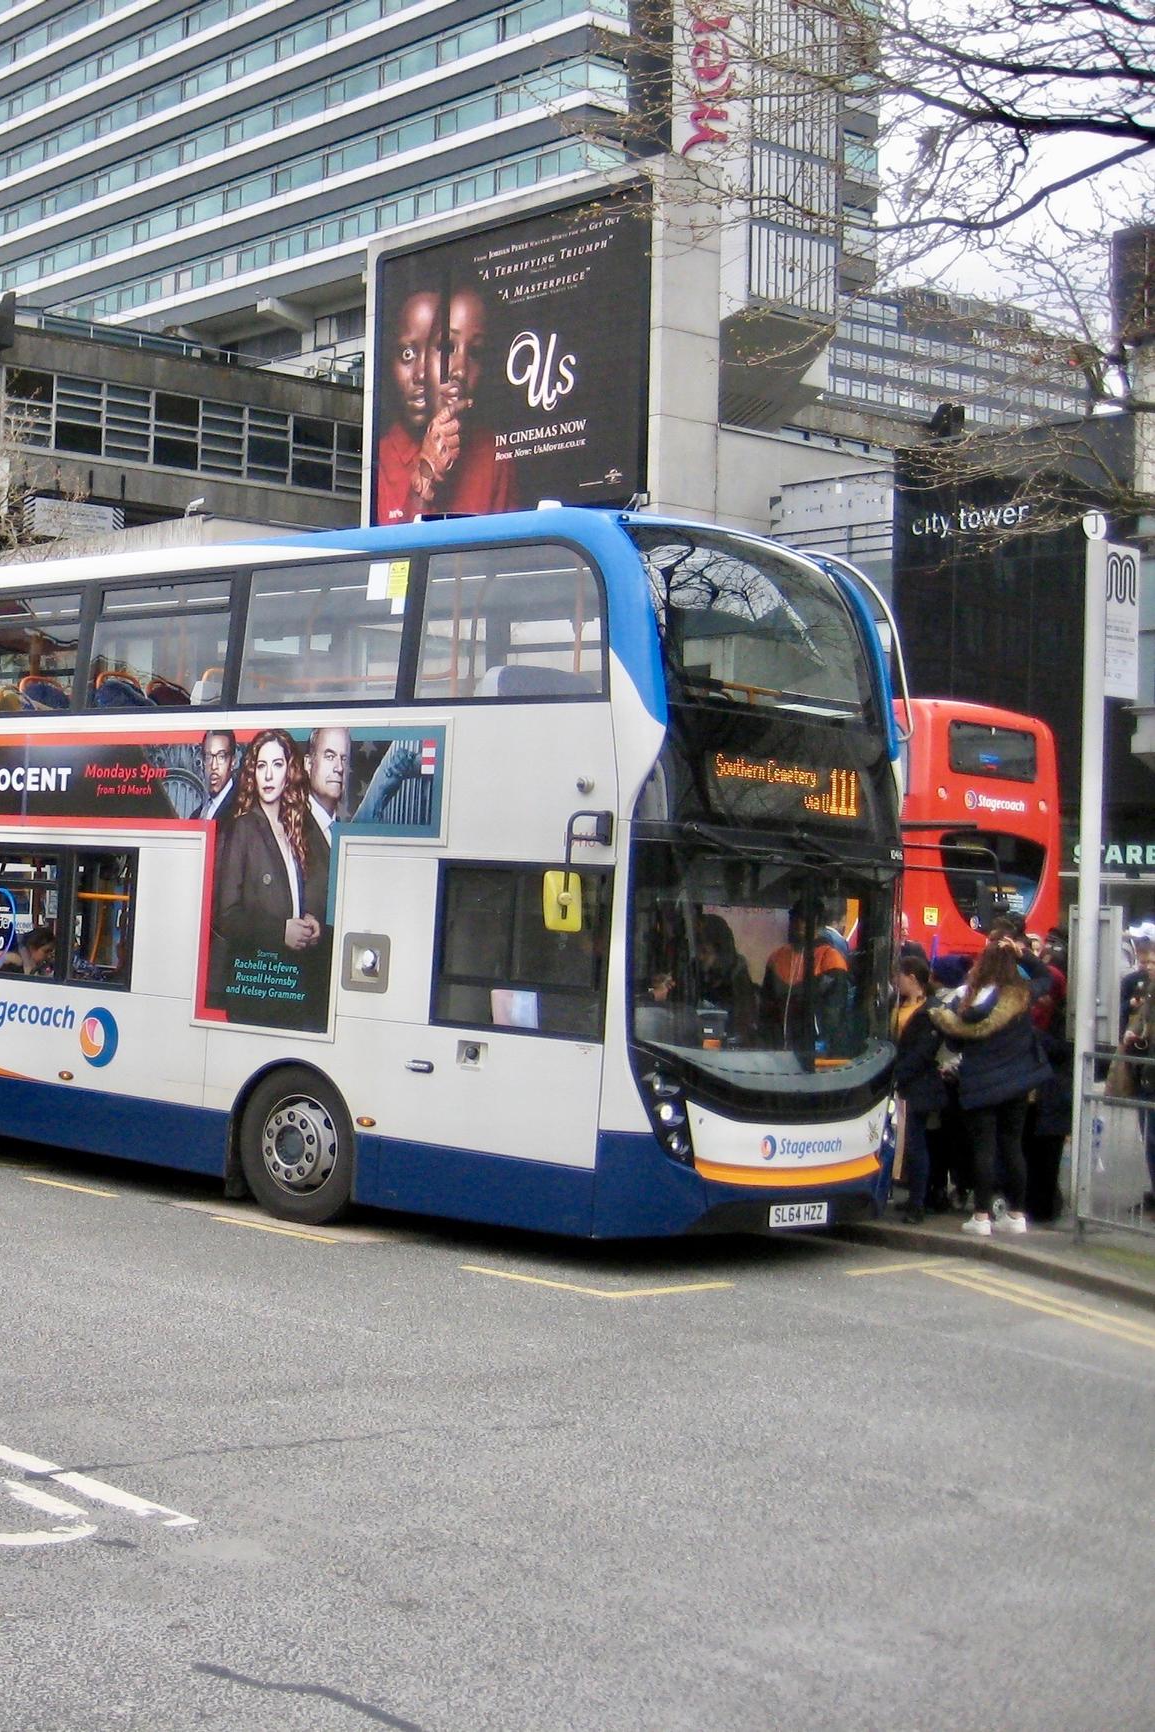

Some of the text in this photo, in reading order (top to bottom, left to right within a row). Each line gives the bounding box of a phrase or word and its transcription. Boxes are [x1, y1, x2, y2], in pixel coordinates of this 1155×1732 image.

[495, 253, 555, 278] TERRIFYING
[506, 331, 577, 411] Us
[495, 419, 587, 447] IN CINEMAS NOW
[912, 504, 1029, 538] city tower
[85, 763, 167, 782] Mondays 9pm
[715, 752, 817, 788] Southern Cemetery
[96, 784, 152, 797] from 18 March
[829, 768, 857, 817] 111
[978, 795, 1025, 812] Stagecoach
[234, 958, 299, 975] Rachelle Lefevre,
[235, 971, 297, 989] Russell Hornsby
[225, 984, 306, 1000] and Kelsey Grammer
[780, 1138, 842, 1158] Stagecoach
[774, 1204, 824, 1223] SL64 HZZ
